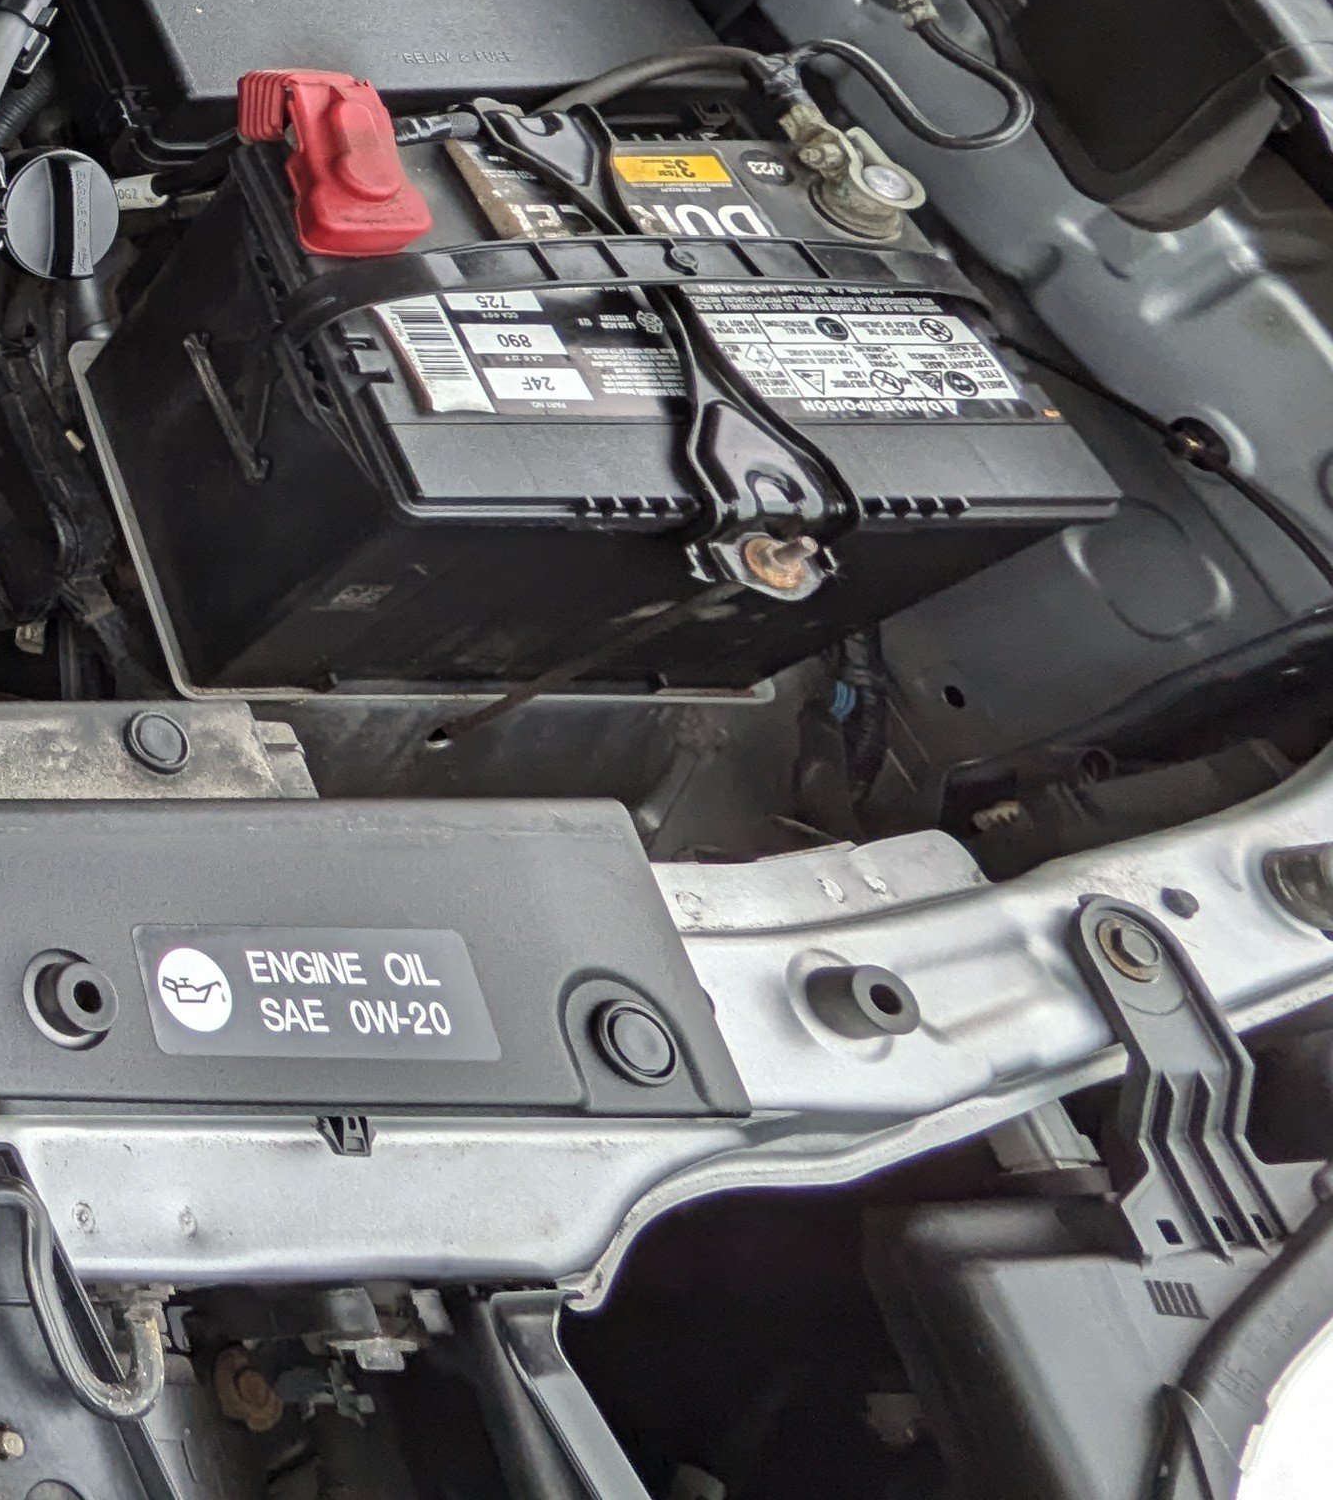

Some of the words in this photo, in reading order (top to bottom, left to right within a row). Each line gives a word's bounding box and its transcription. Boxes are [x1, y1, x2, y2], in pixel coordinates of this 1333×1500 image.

[402, 51, 450, 64] RELAY
[674, 158, 697, 179] 3
[747, 160, 786, 176] 4/23
[475, 295, 511, 308] 725
[497, 333, 532, 348] 890
[521, 376, 555, 392] 24F
[800, 399, 944, 412] DANGER/POISON
[245, 950, 368, 986] ENGINE
[383, 952, 441, 987] OIL
[260, 997, 330, 1033] SAE
[349, 1001, 452, 1036] 0W-20
